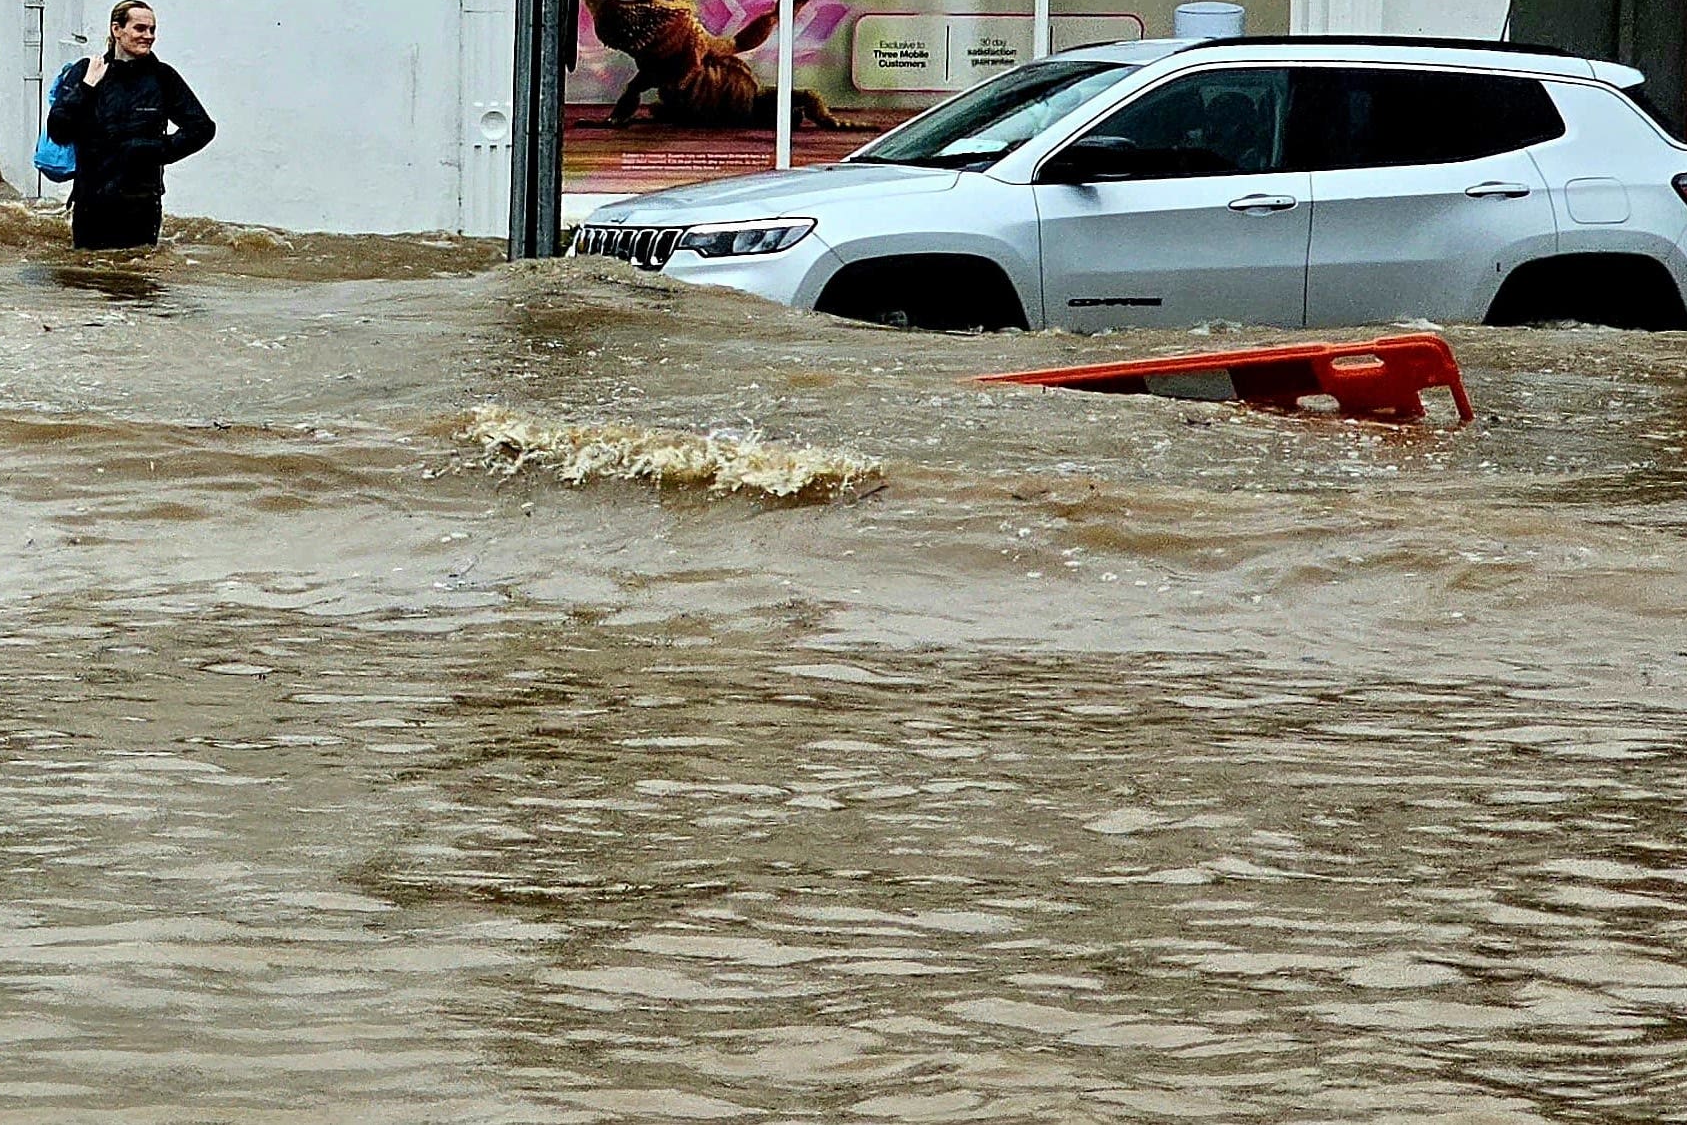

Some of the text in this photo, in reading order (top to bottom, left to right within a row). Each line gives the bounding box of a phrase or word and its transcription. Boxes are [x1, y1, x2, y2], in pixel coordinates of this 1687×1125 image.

[879, 40, 926, 49] Exclusive to
[992, 37, 1007, 48] day
[873, 49, 929, 58] Three Mobile
[967, 48, 1017, 57] satisfaction
[878, 59, 926, 68] Customers
